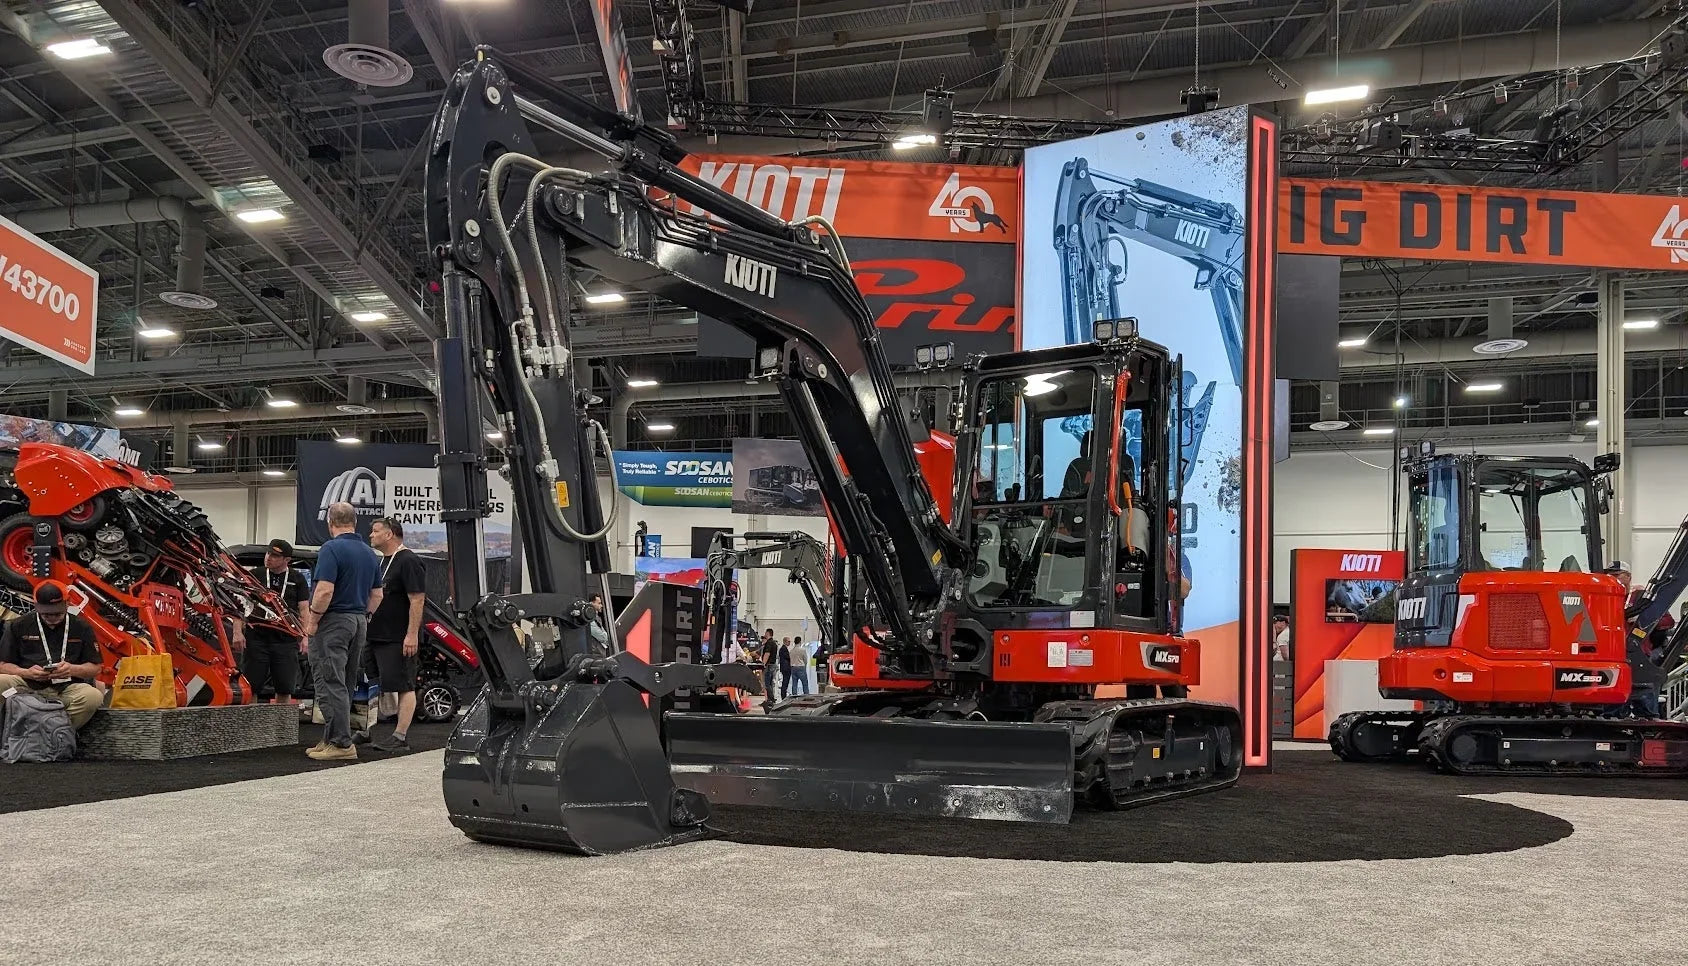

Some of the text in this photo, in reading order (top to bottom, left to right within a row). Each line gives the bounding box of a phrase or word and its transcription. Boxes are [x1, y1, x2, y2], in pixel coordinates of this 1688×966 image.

[690, 162, 846, 229] KIOTI
[1290, 185, 1576, 257] IG DIRT
[1174, 219, 1211, 249] KIOTI
[724, 253, 777, 299] KIOTI
[394, 485, 433, 498] BUILT
[674, 487, 709, 496] SOOSAN
[393, 499, 441, 511] WHERE
[393, 513, 436, 525] CAN'T
[760, 550, 782, 566] KIOTI
[1340, 553, 1383, 572] KIOTI
[1562, 596, 1581, 606] KIOTI
[1397, 596, 1427, 621] KIOTI
[123, 675, 155, 685] CASE
[1560, 672, 1603, 683] MX350
